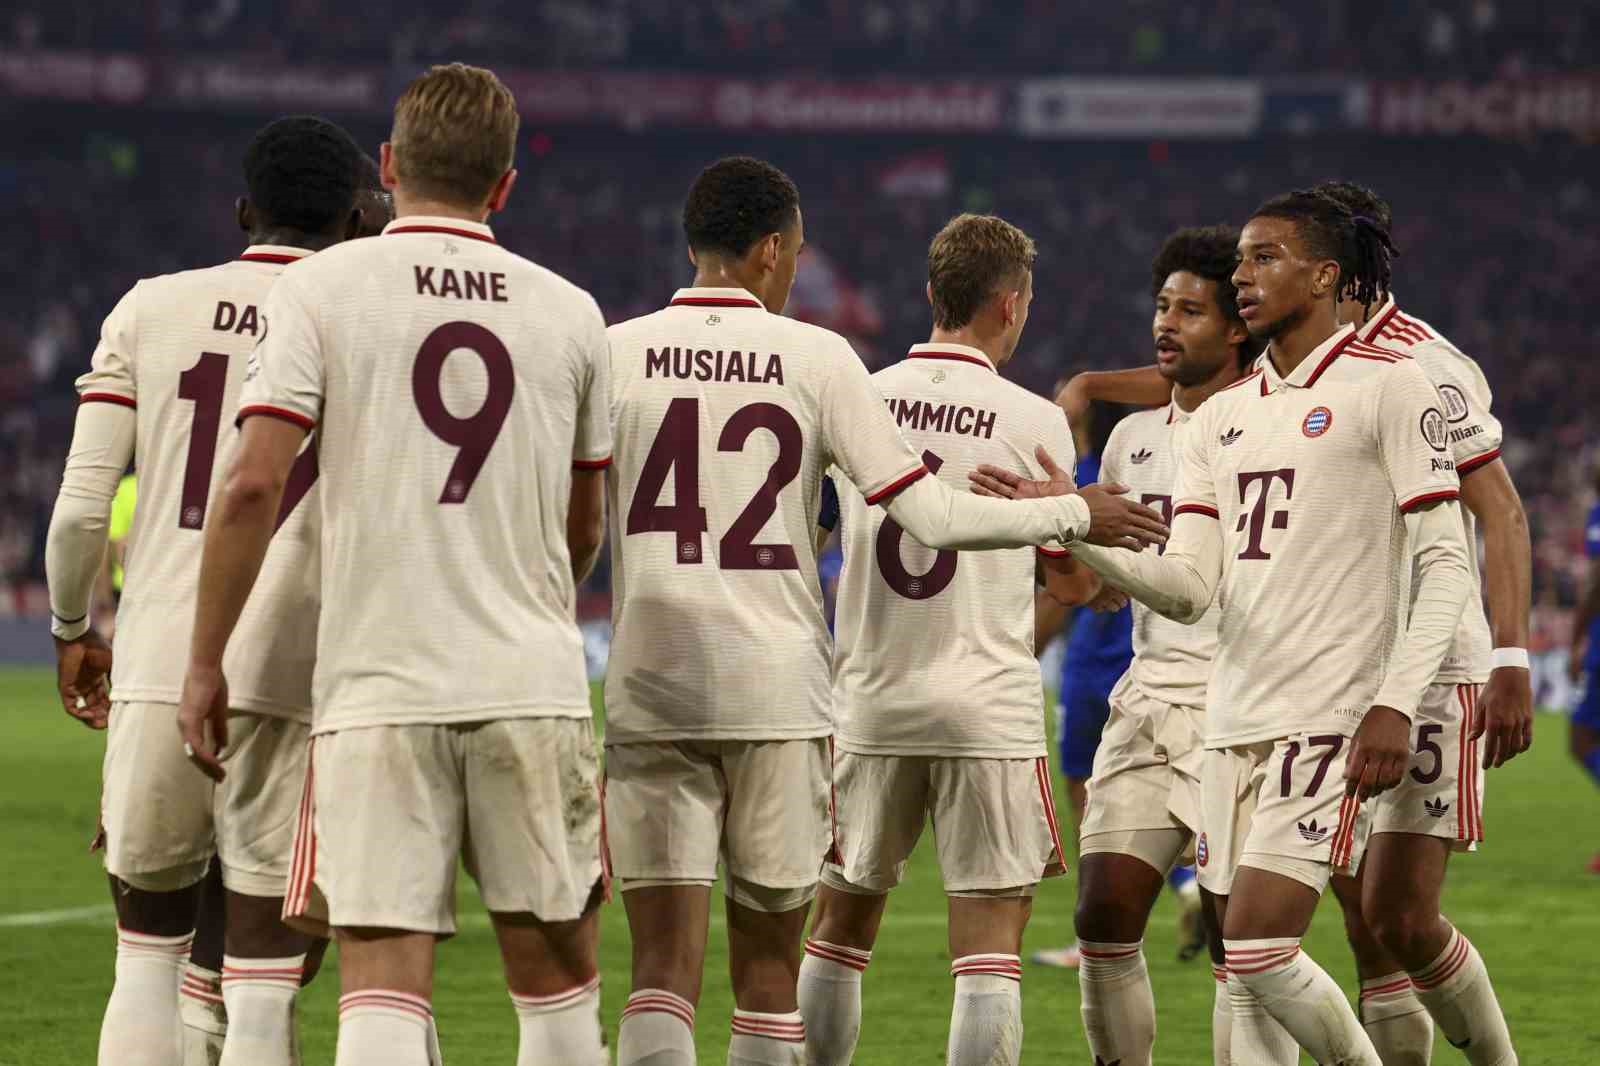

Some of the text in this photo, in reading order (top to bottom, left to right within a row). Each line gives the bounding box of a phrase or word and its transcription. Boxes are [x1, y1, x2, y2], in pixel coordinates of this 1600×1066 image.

[413, 264, 509, 303] KANE
[645, 346, 785, 386] MUSIALA
[411, 320, 516, 505] 9
[884, 398, 997, 439] IMMICH
[626, 397, 804, 571] 42
[1280, 735, 1343, 797] 17
